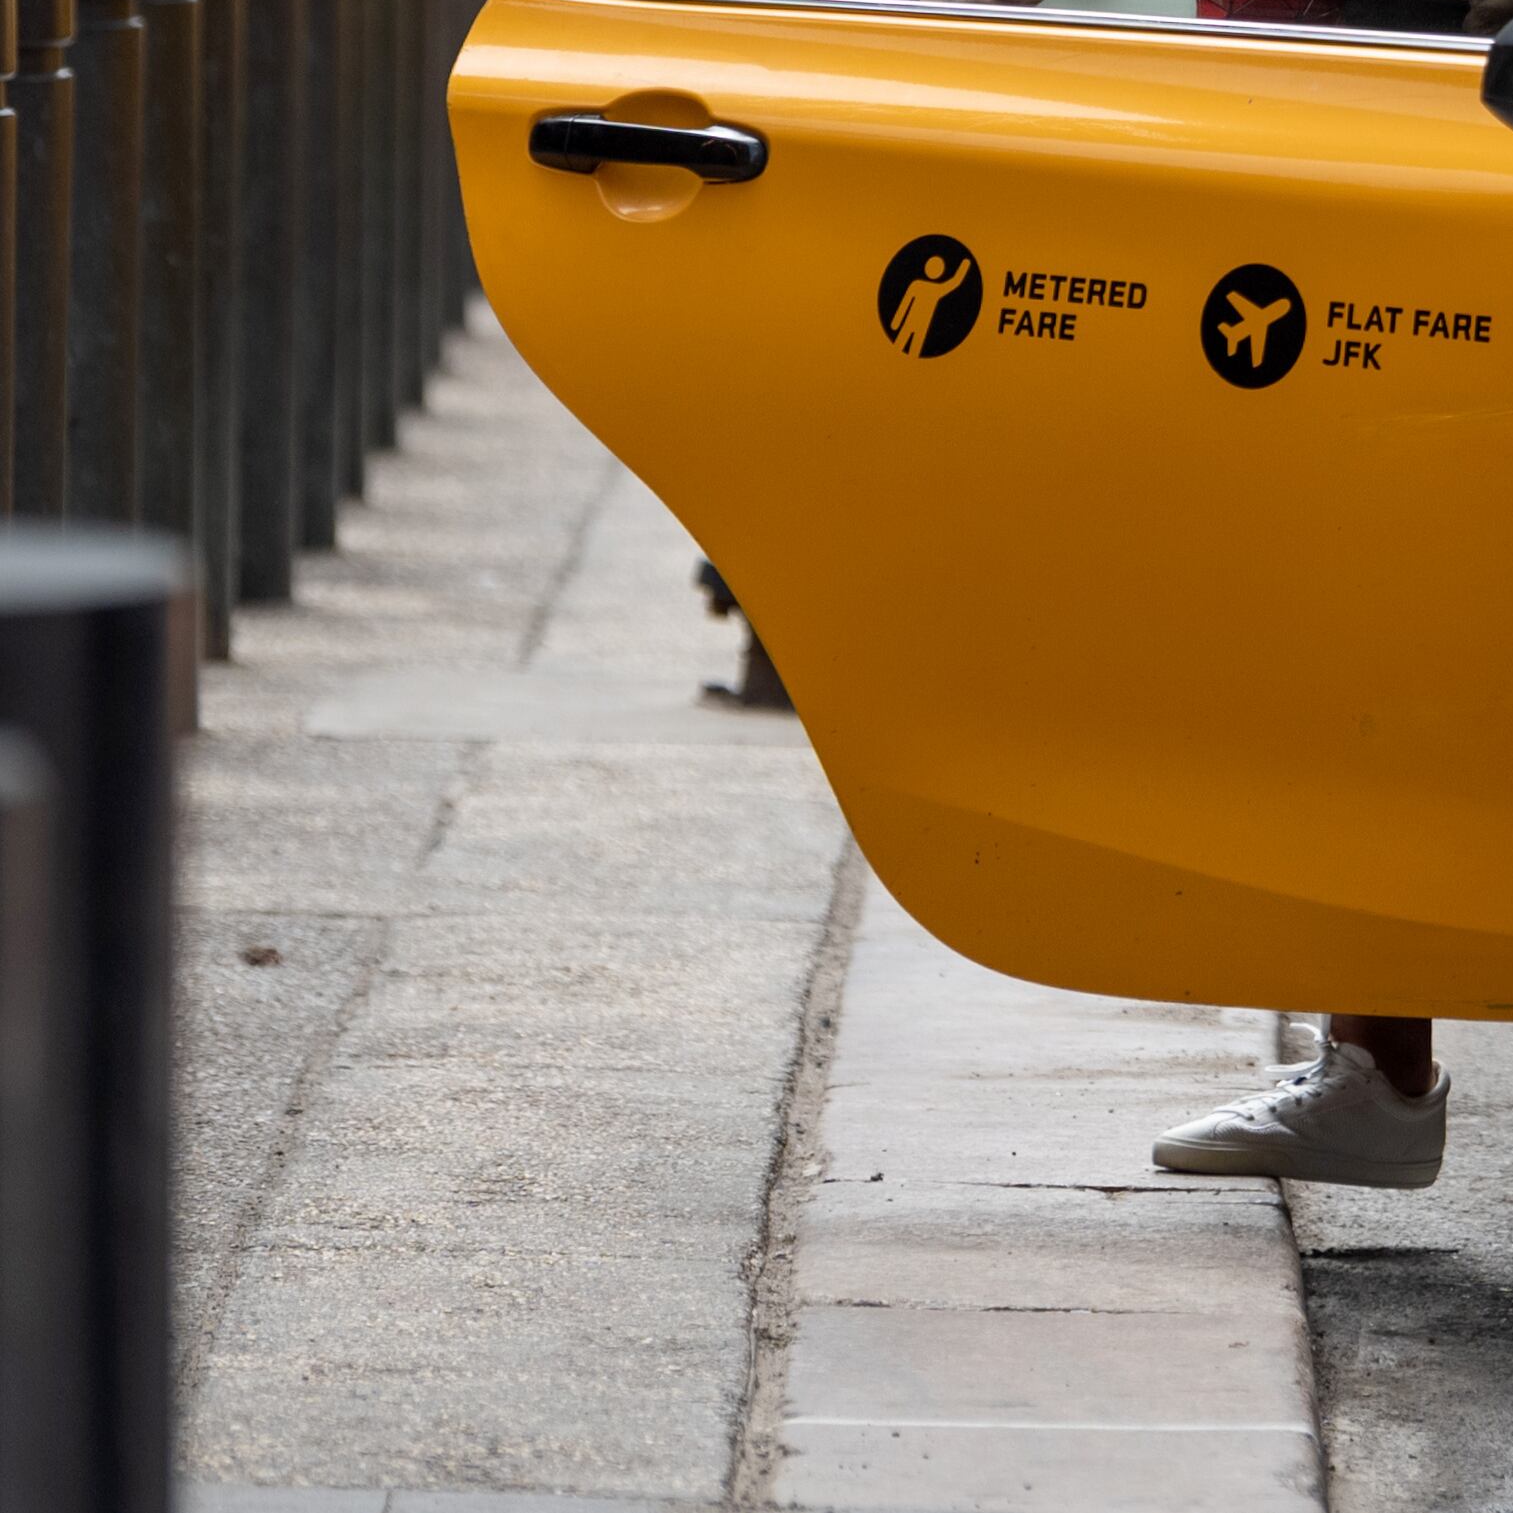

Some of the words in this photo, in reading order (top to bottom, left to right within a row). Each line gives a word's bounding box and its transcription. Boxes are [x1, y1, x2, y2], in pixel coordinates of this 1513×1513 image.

[1003, 270, 1148, 310] METERED
[999, 309, 1077, 341] FARE
[1327, 301, 1404, 334] FLAT
[1413, 310, 1492, 343] FARE
[1322, 339, 1383, 371] JFK
